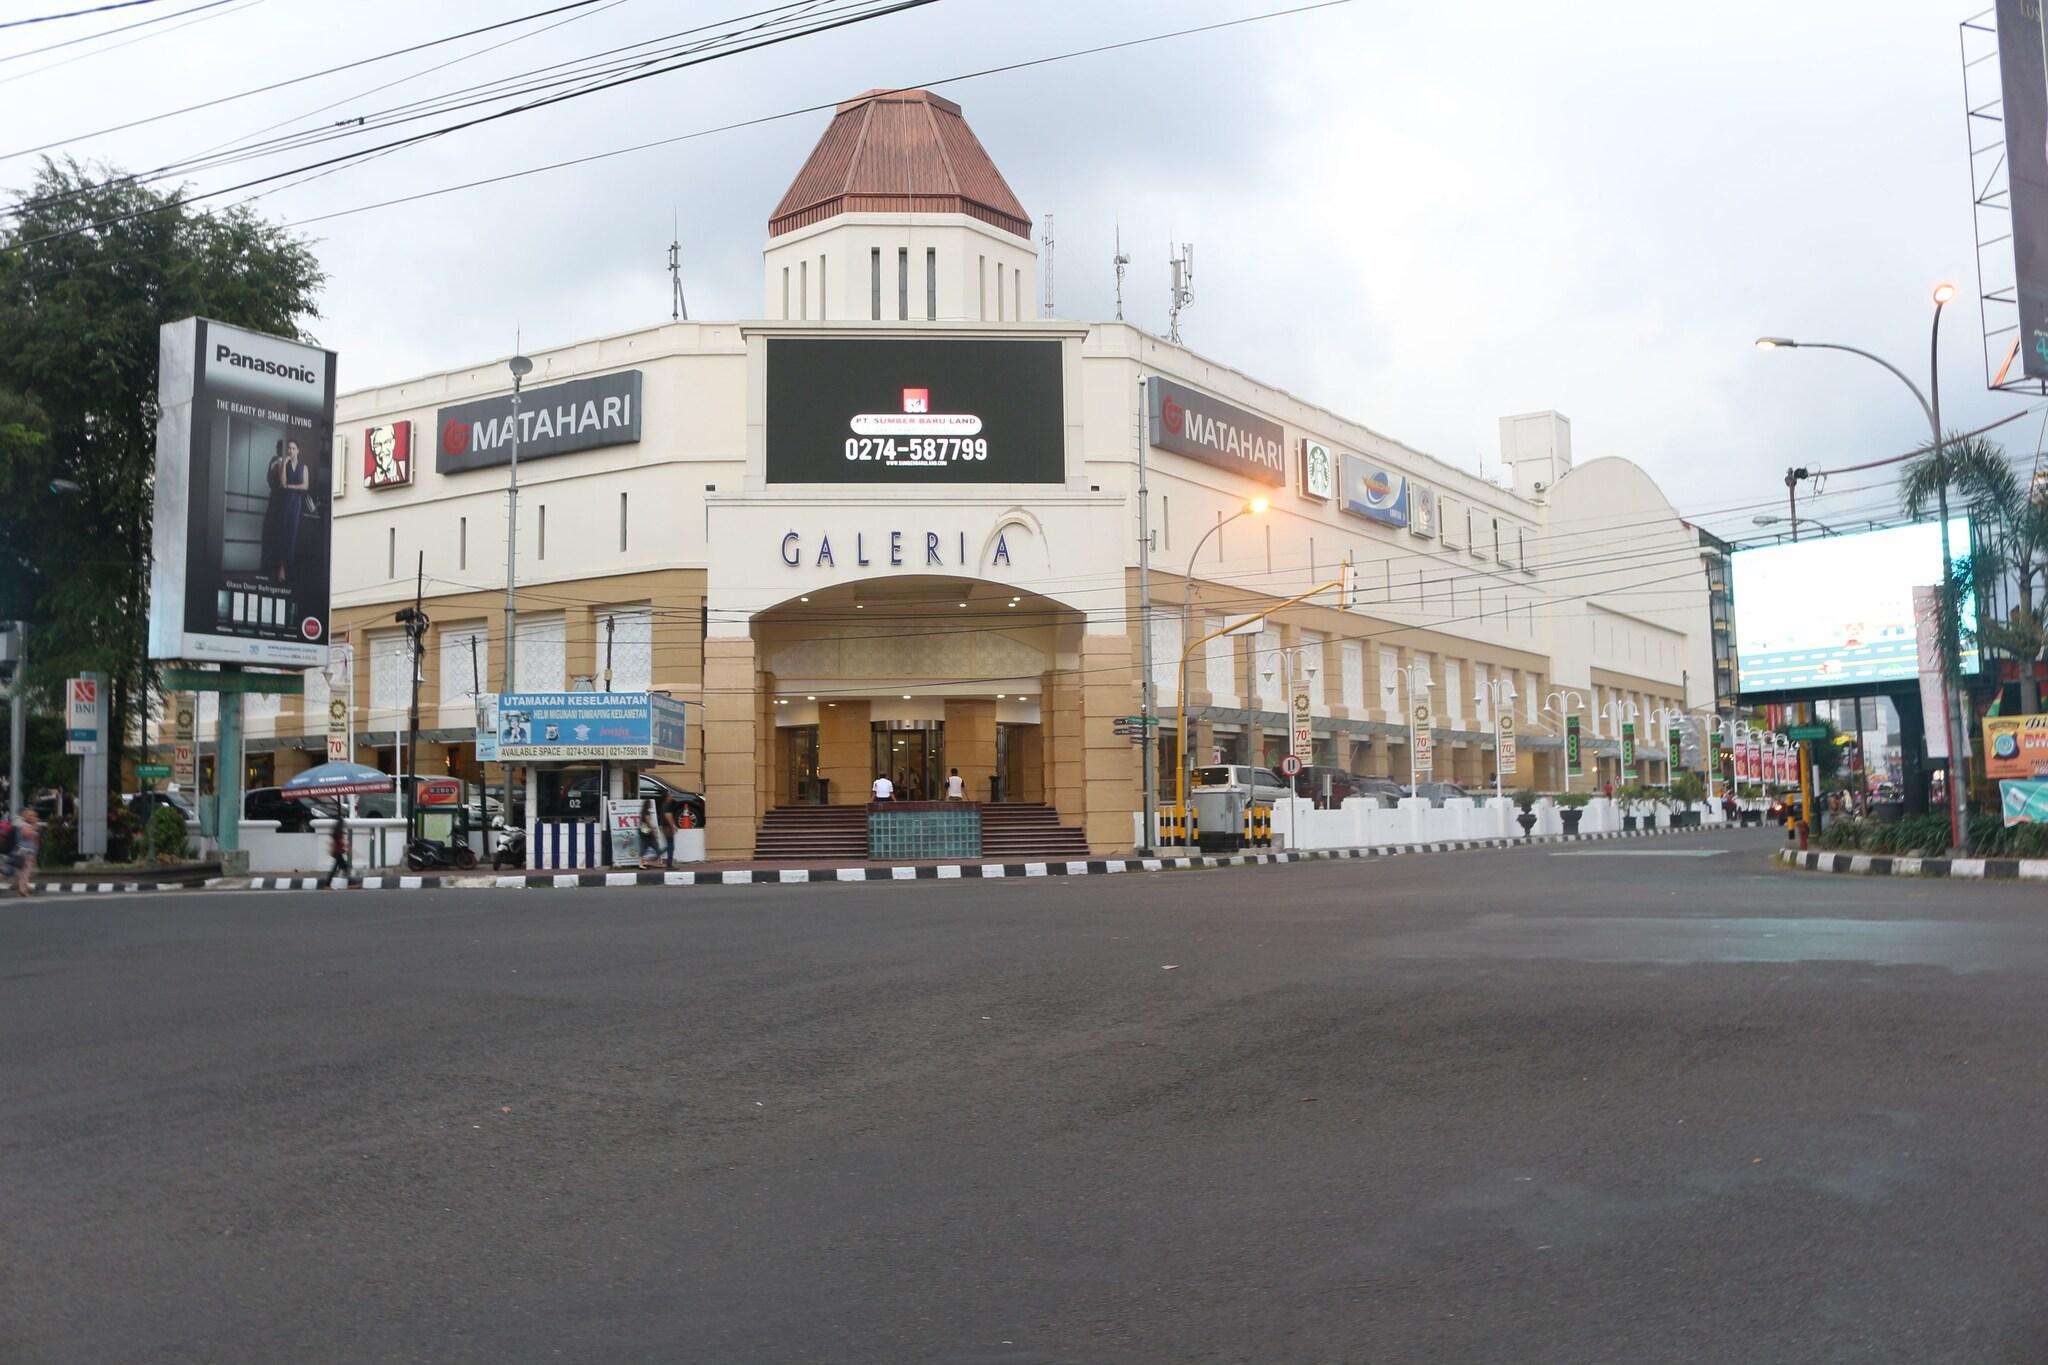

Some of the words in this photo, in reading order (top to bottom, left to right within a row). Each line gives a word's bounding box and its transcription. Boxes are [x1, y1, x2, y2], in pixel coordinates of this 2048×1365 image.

[216, 344, 315, 384] Panasonic
[216, 399, 228, 410] THE
[231, 402, 256, 416] BEAUTY
[258, 408, 265, 418] OF
[268, 411, 290, 423] SMART
[291, 416, 312, 428] LIVING
[472, 394, 630, 451] MATAHARI
[845, 438, 987, 461] 0274-587799
[1185, 409, 1283, 471] MATAHARI
[781, 531, 1011, 567] GALERIA
[75, 704, 95, 713] BNI
[504, 696, 565, 706] UTAMAKAN
[568, 695, 648, 706] KESELAMATAN
[501, 747, 538, 756] AVAILABLE
[539, 747, 560, 756] SPACE
[569, 799, 581, 808] 02
